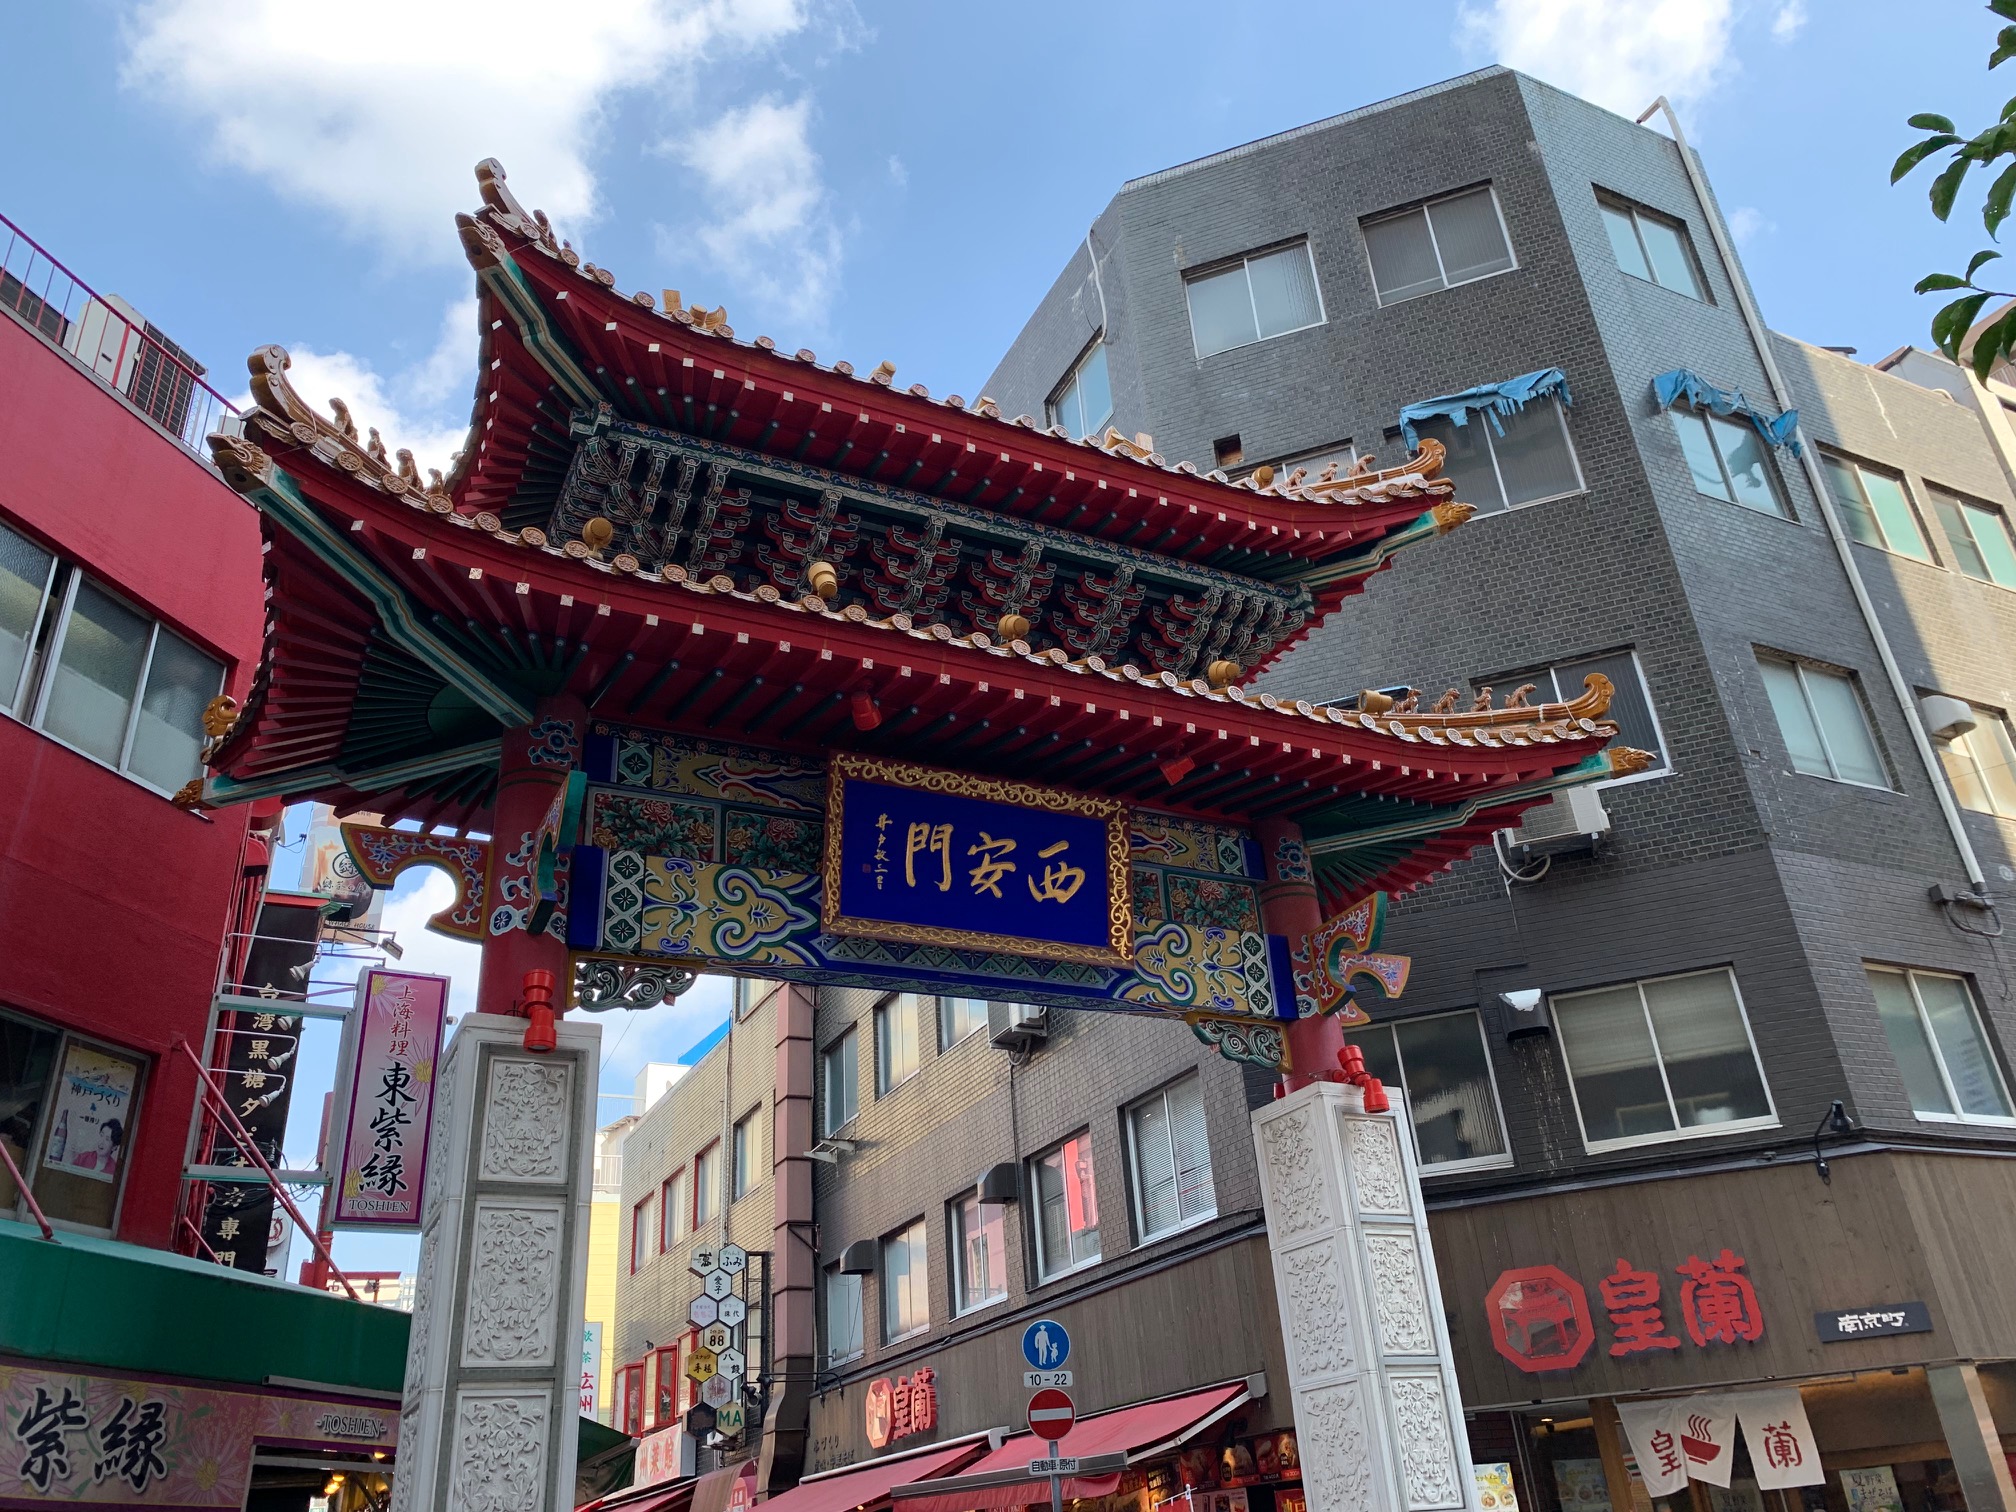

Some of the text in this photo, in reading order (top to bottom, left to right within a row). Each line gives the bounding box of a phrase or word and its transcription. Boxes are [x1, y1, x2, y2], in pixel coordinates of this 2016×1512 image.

[905, 822, 1086, 904] 西安門
[389, 985, 415, 1057] 上海料理
[71, 1082, 120, 1107] 神戸づくり
[359, 1061, 418, 1197] 東紫縁
[349, 1199, 411, 1213] TOSHIEN
[722, 1256, 742, 1267] ふみ
[1599, 1249, 1763, 1356] 皇蘭
[1838, 1311, 1906, 1333] 南京町
[709, 1334, 725, 1347] 88
[17, 1387, 167, 1494] 紫縁
[1650, 1420, 1803, 1476] 皇 蘭
